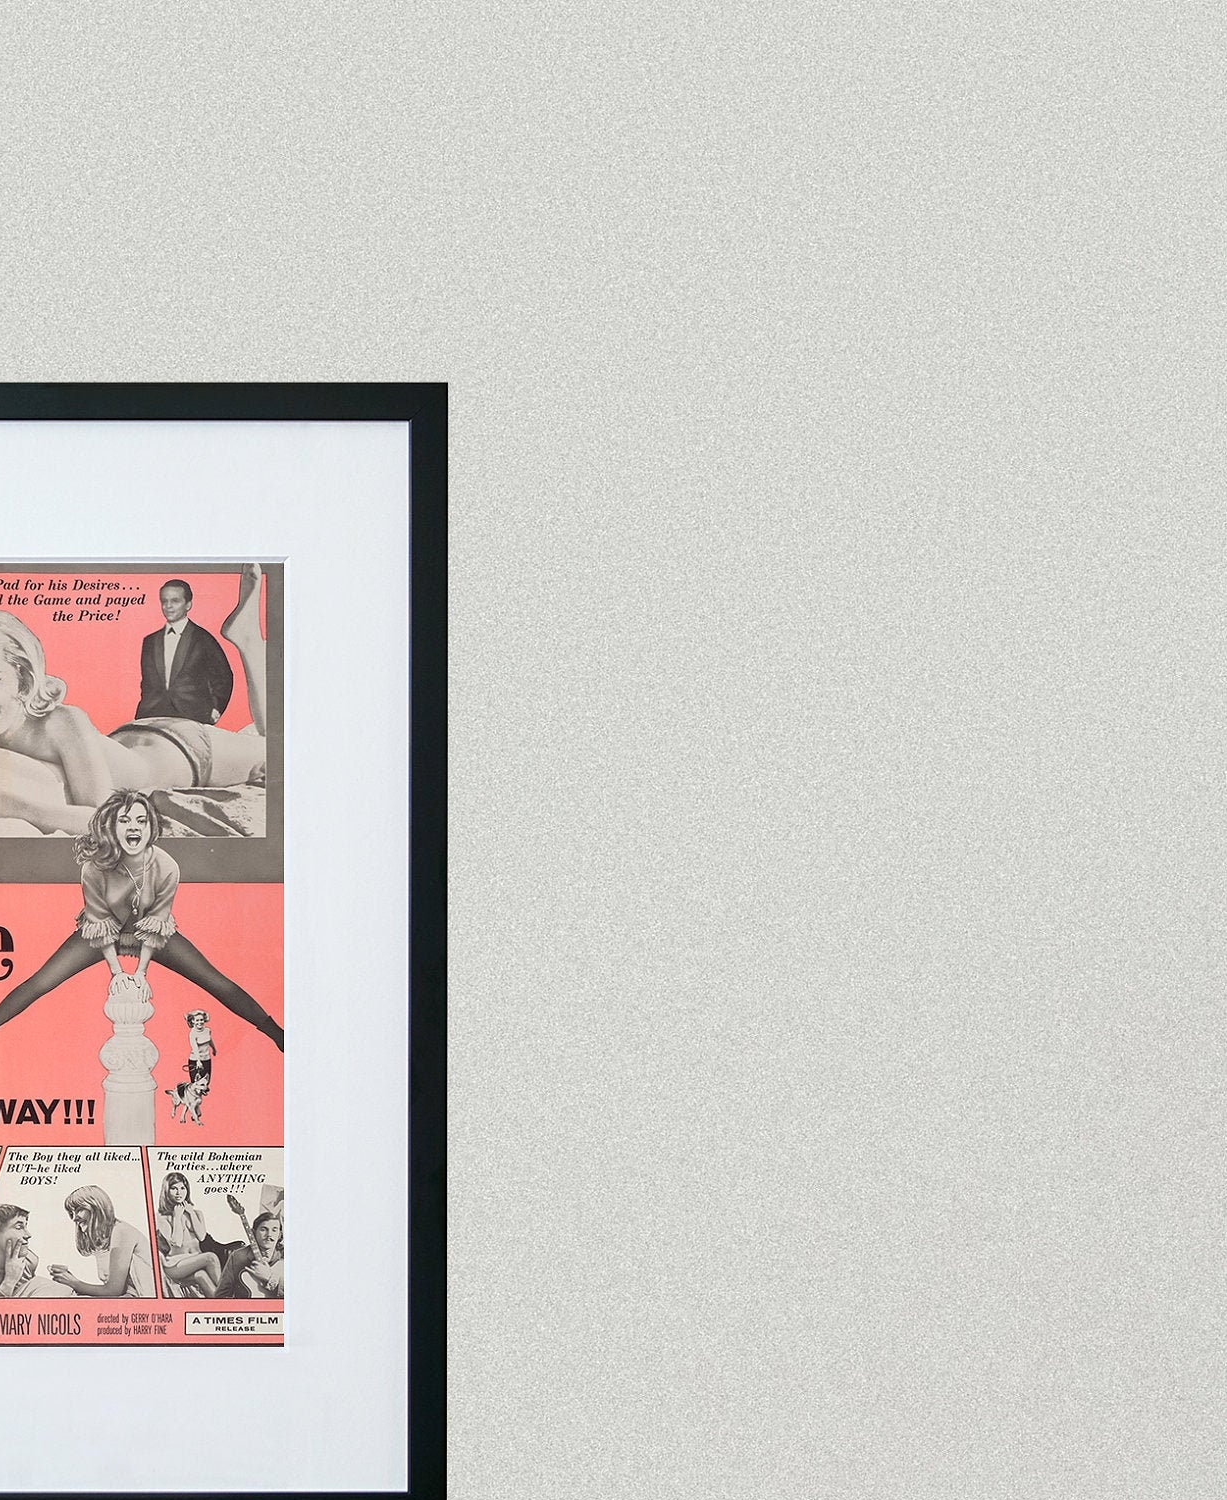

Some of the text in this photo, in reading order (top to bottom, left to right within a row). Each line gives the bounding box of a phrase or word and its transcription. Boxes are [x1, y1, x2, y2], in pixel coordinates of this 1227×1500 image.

[24, 579, 44, 592] for
[48, 579, 68, 592] his
[73, 580, 140, 592] Desires...
[8, 594, 29, 607] the
[33, 594, 71, 607] Game
[75, 594, 100, 607] and
[105, 594, 146, 609] payed
[53, 609, 121, 622] the Price!
[8, 1151, 141, 1165] The Boy they all liked...
[157, 1151, 263, 1162] The wild Bohemian
[53, 1162, 81, 1174] liked
[20, 1175, 59, 1186] BOYS!
[197, 1173, 265, 1183] ANYTHING
[204, 1184, 247, 1195] goes!!!
[38, 1313, 81, 1336] NICOLS
[97, 1314, 120, 1323] directed
[120, 1314, 128, 1325] by
[131, 1313, 148, 1323] GERRY
[193, 1316, 278, 1325] A TIMES FILM
[97, 1325, 166, 1336] produced by HARRY FINE
